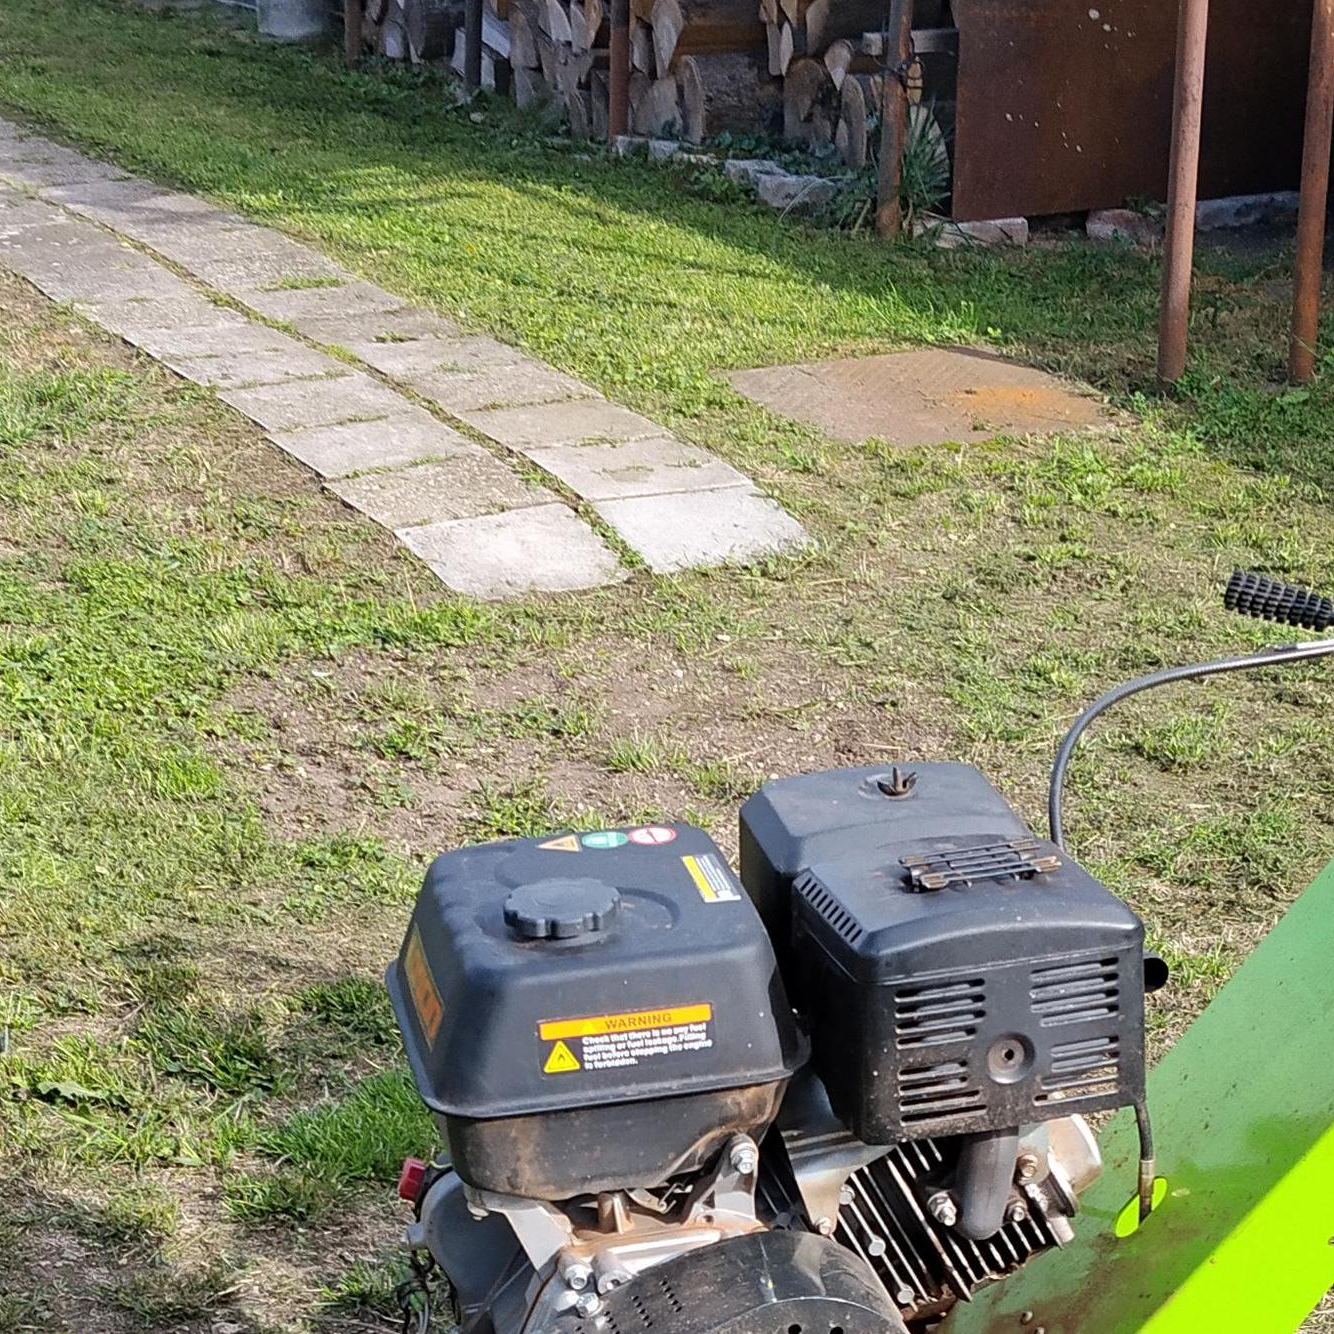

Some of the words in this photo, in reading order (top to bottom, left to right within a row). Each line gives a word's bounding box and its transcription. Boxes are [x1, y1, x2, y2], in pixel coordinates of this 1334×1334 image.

[604, 1013, 672, 1030] WARNING
[582, 1034, 610, 1046] Check
[610, 1032, 628, 1042] that
[628, 1030, 651, 1041] there
[689, 1022, 706, 1032] fuel
[583, 1052, 601, 1062] fuel
[668, 1042, 683, 1052] the
[627, 1039, 644, 1049] fuel
